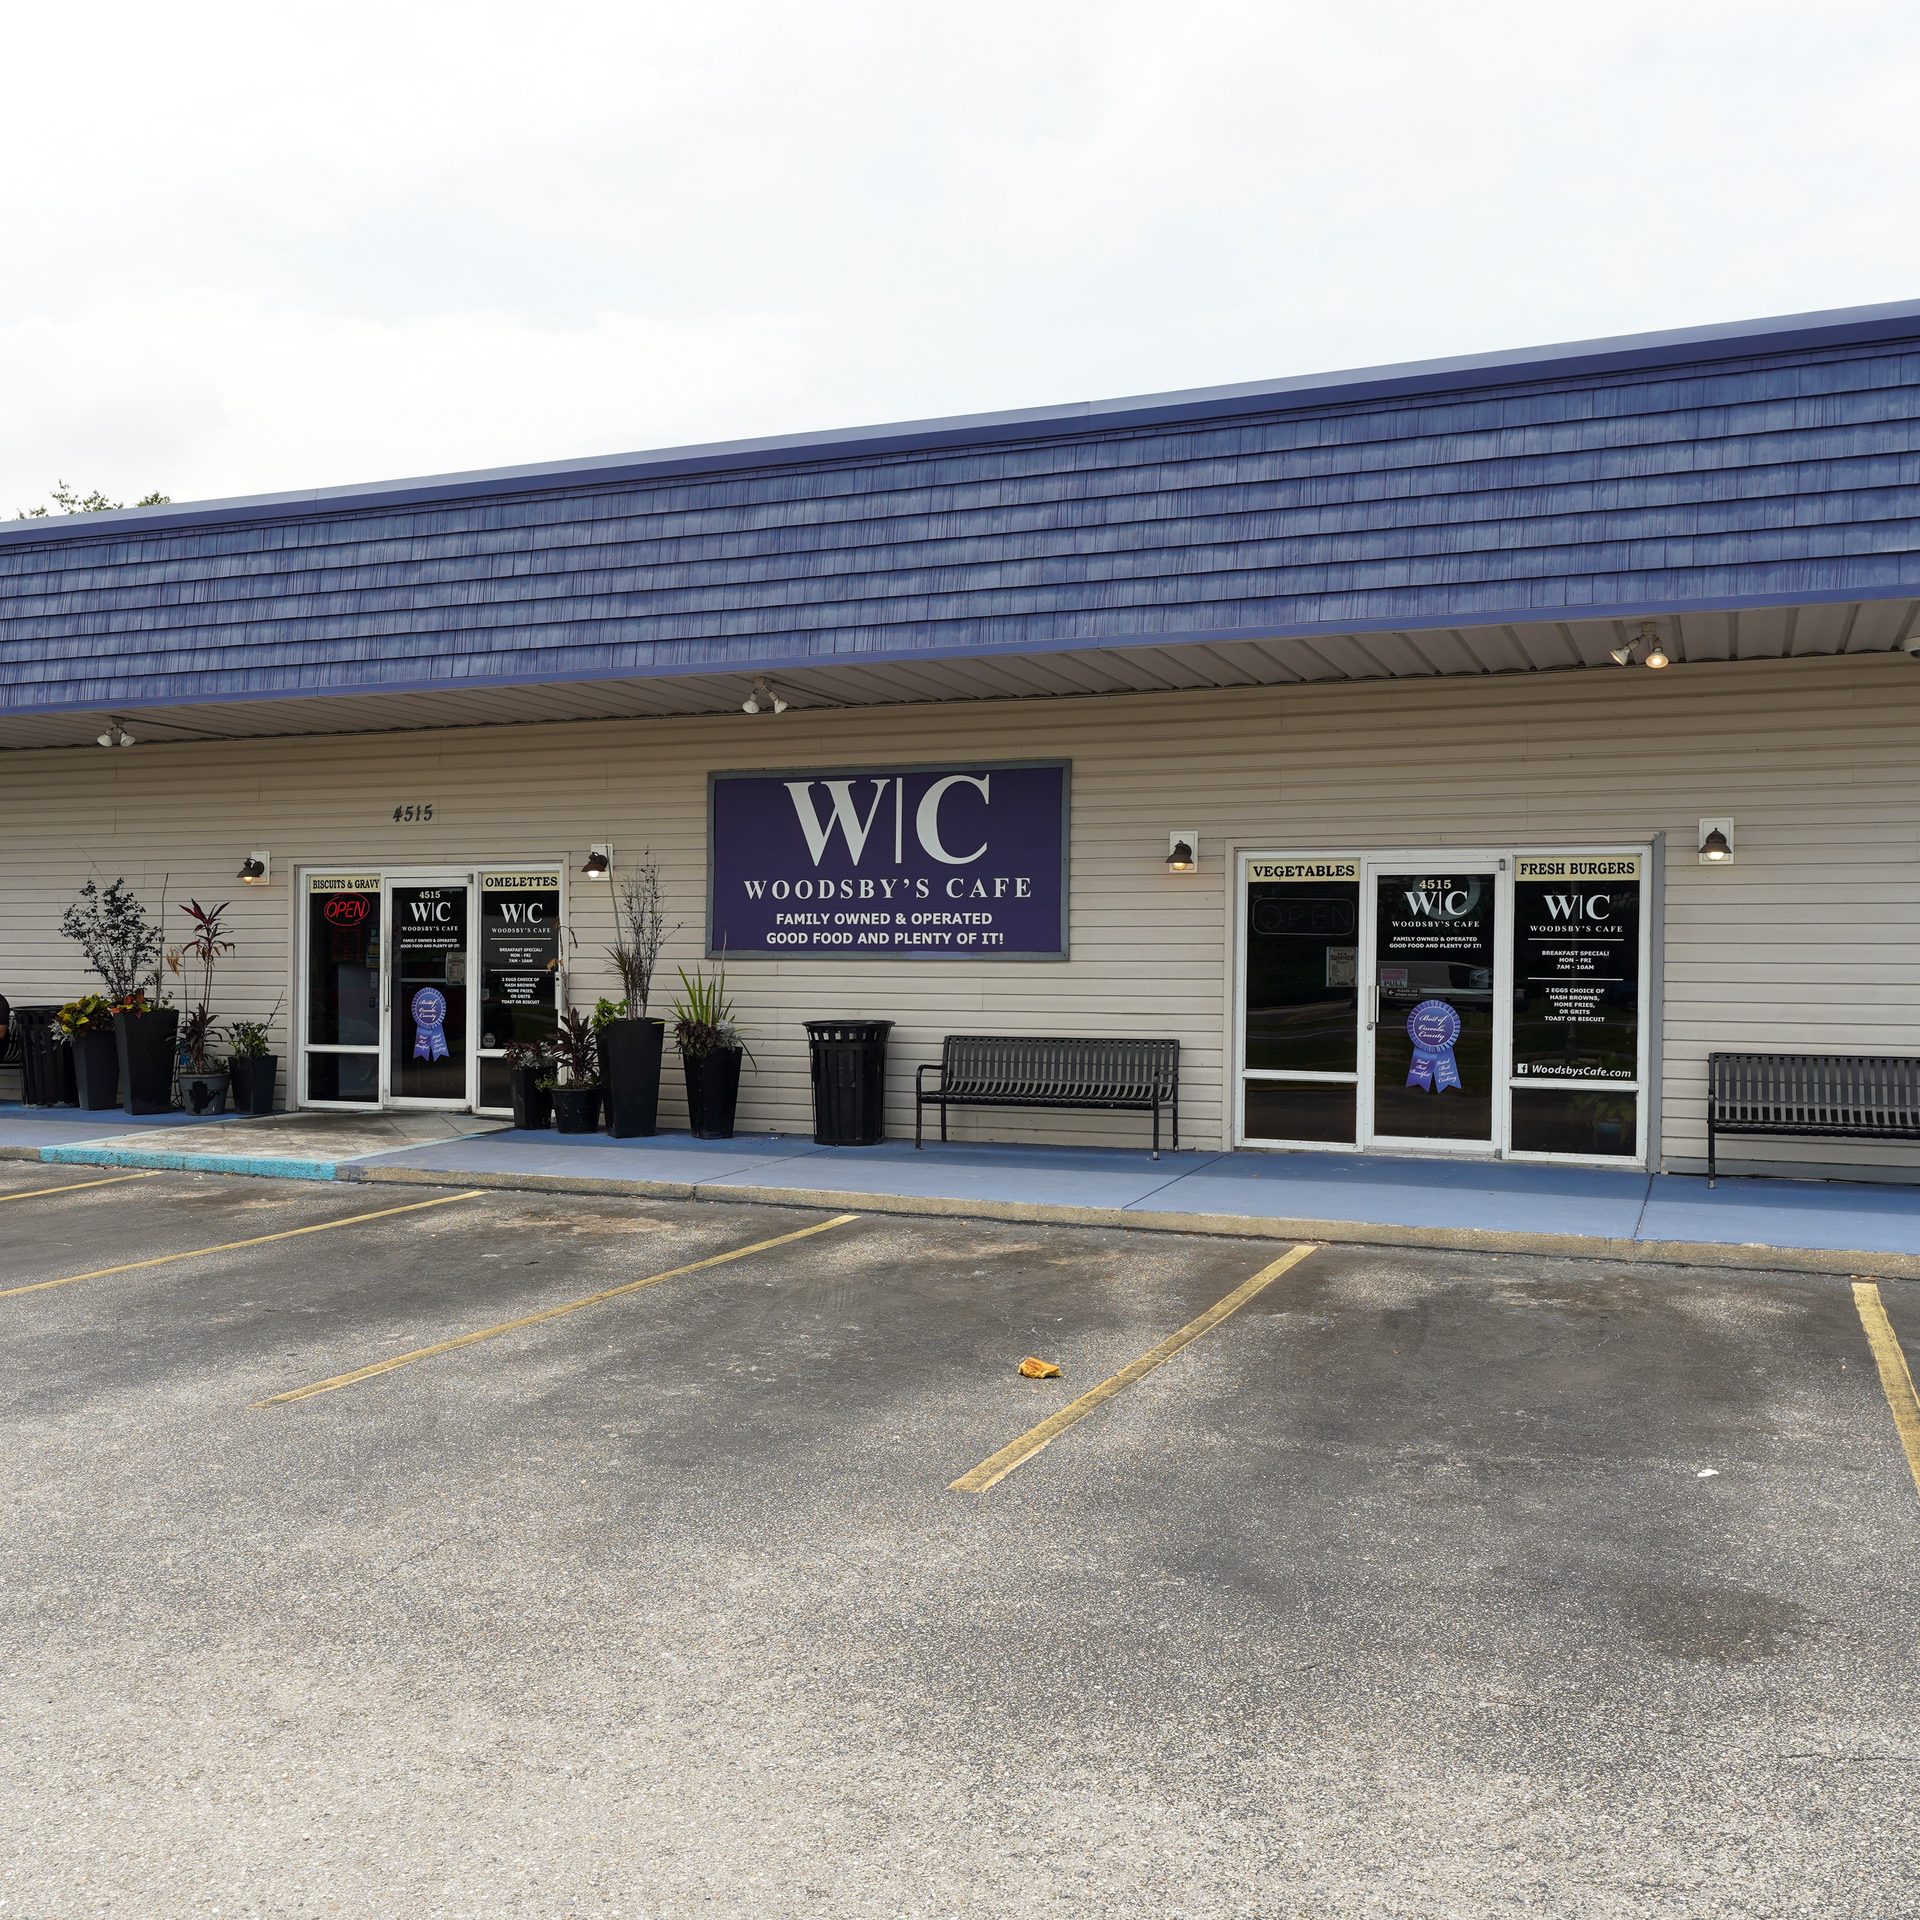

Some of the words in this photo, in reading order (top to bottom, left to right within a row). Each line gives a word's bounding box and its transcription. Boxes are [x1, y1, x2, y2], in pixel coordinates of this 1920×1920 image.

[392, 803, 433, 823] 4515
[1252, 865, 1356, 877] VEGETABLES
[1520, 862, 1566, 875] FRESH
[1569, 861, 1635, 875] BURGERS
[312, 879, 346, 889] BISCUITS
[347, 879, 353, 889] &
[354, 878, 380, 889] GRAVY
[485, 876, 558, 888] OMELETTES
[1418, 879, 1452, 890] 4515
[419, 890, 441, 899] 4515
[743, 878, 930, 900] WOODSBY'S
[945, 877, 1032, 899] CAFE
[326, 900, 366, 918] OPEN
[775, 913, 831, 925] FAMILY
[833, 913, 891, 925] OWNED
[895, 913, 907, 925] &
[910, 912, 993, 925] OPERATED
[1391, 920, 1450, 928] WOODSBY'S
[1453, 920, 1480, 928] CAFE
[1595, 925, 1623, 933] CAFE
[766, 932, 808, 945] GOOD
[812, 932, 853, 945] FOOD
[857, 932, 890, 945] AND
[894, 932, 952, 945] PLENTY
[956, 932, 977, 945] OF
[981, 932, 1004, 945] IT!
[1419, 1014, 1437, 1022] Best
[1437, 1015, 1448, 1026] of
[1418, 1031, 1445, 1043] County
[1531, 1064, 1632, 1077] WoodsbysCafe.com
